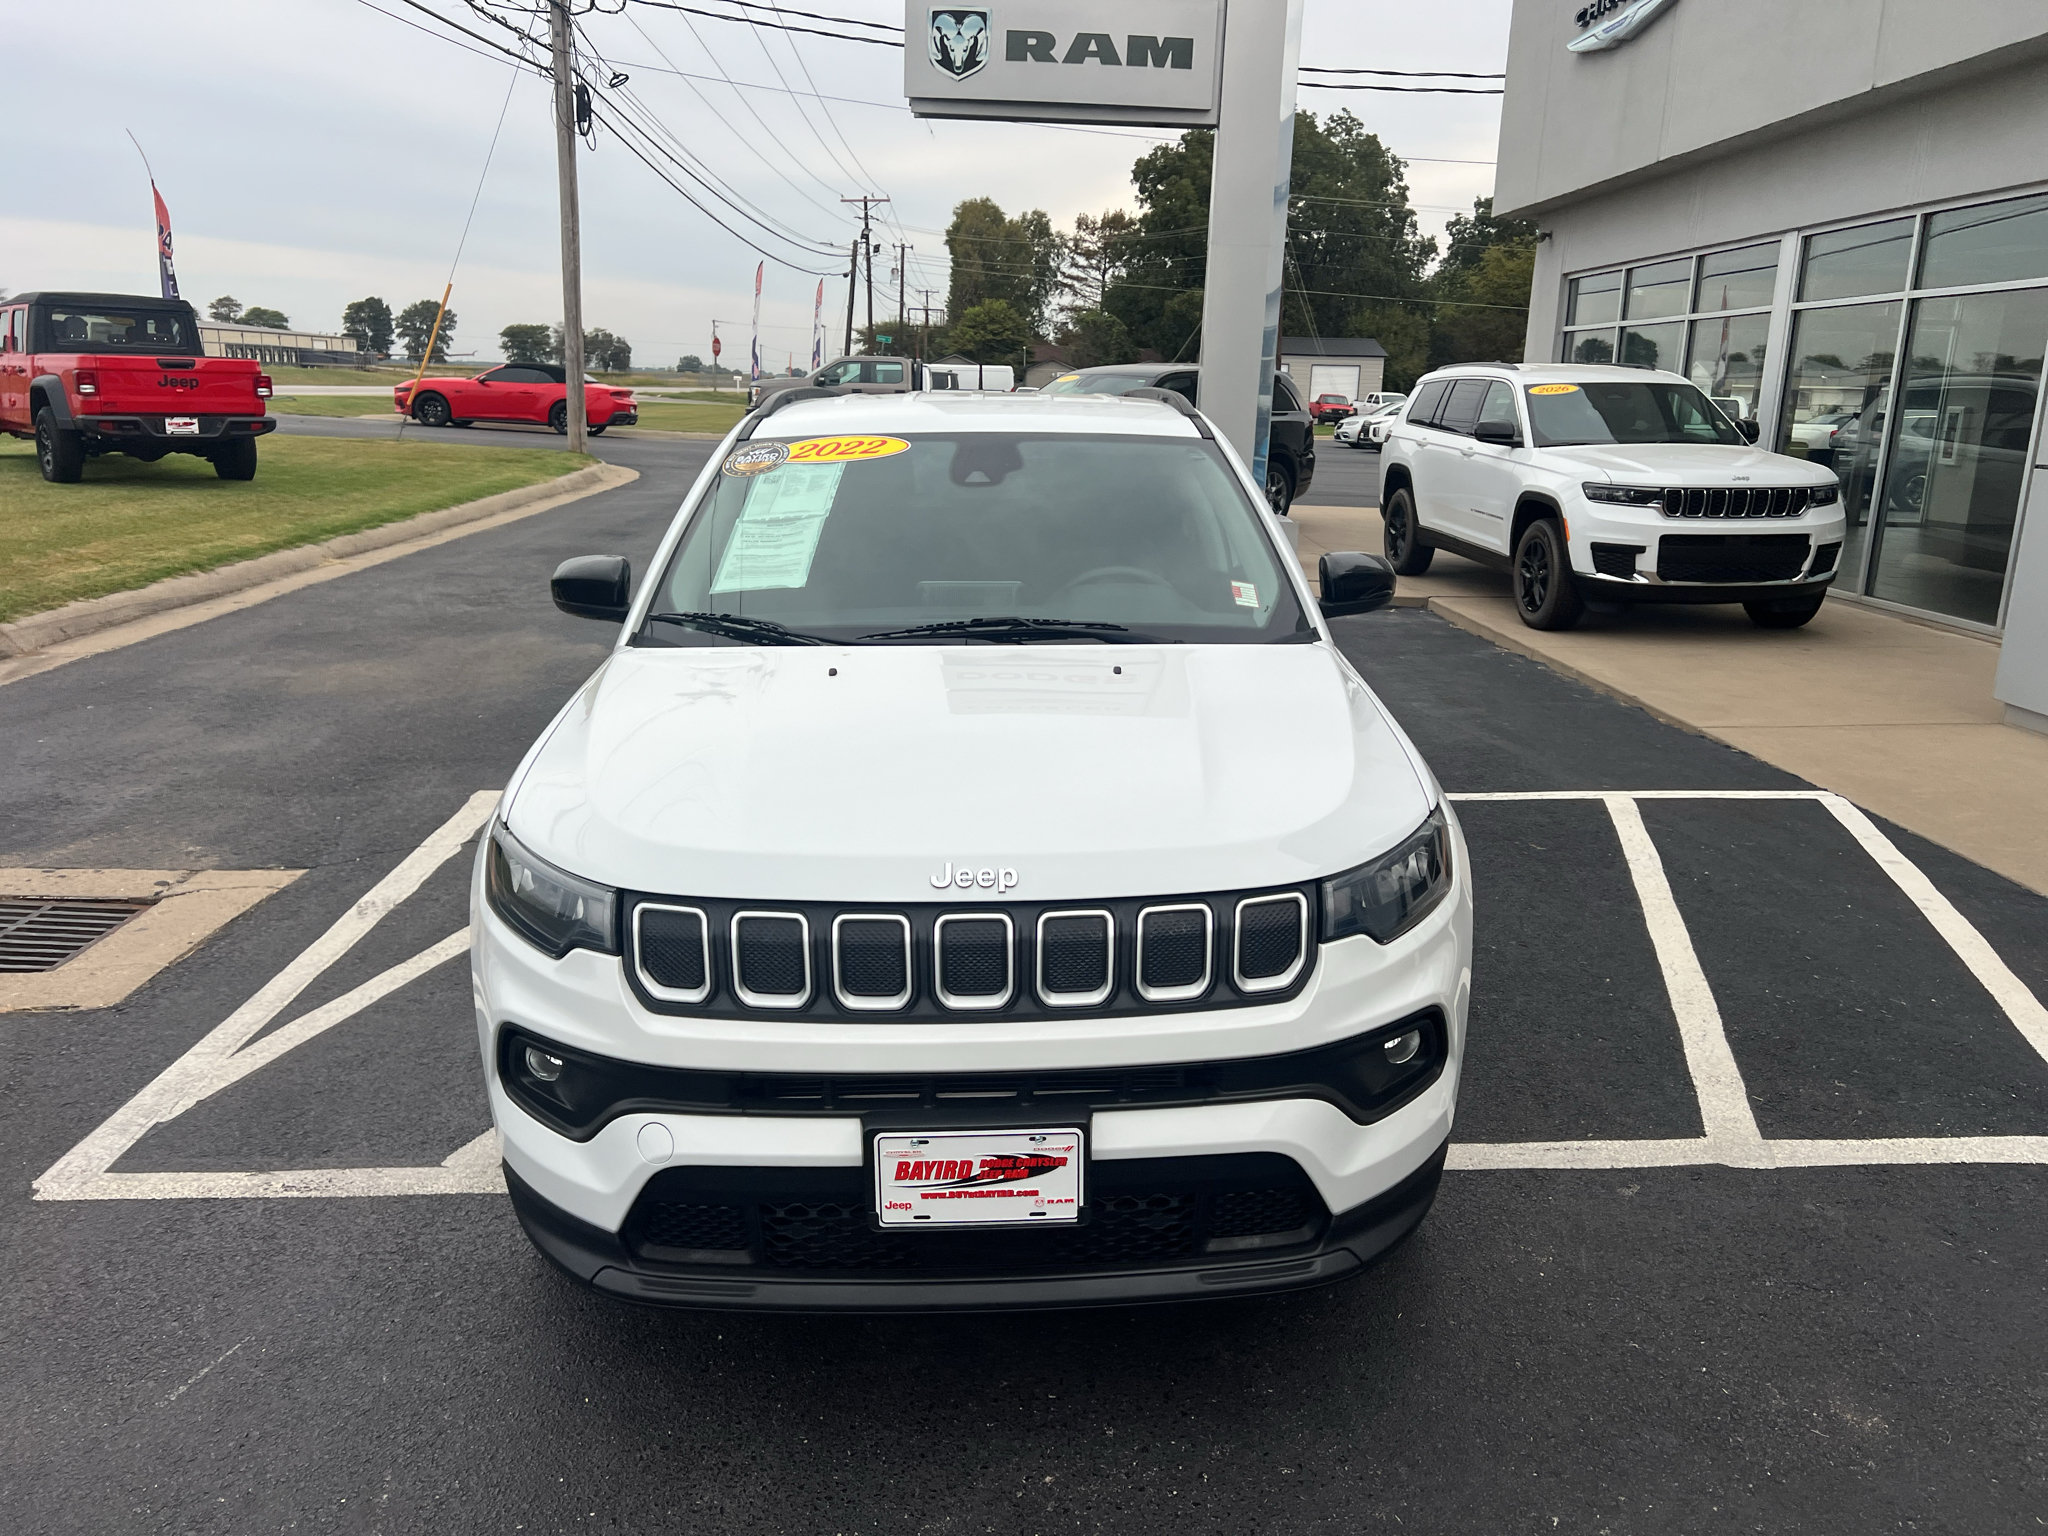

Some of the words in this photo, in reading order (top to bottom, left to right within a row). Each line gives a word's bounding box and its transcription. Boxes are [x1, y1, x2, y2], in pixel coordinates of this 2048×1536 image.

[1005, 29, 1194, 70] RAM
[157, 374, 199, 390] Jeep
[1537, 386, 1570, 394] 2026
[789, 439, 888, 460] 2022
[929, 862, 1019, 894] Jeep
[894, 1160, 974, 1181] BAYIRD
[979, 1159, 1015, 1169] DODGE
[1016, 1156, 1068, 1167] CHRYSLER
[976, 1170, 1002, 1180] JEEP
[1003, 1168, 1030, 1179] RAM
[884, 1200, 913, 1211] Jeep
